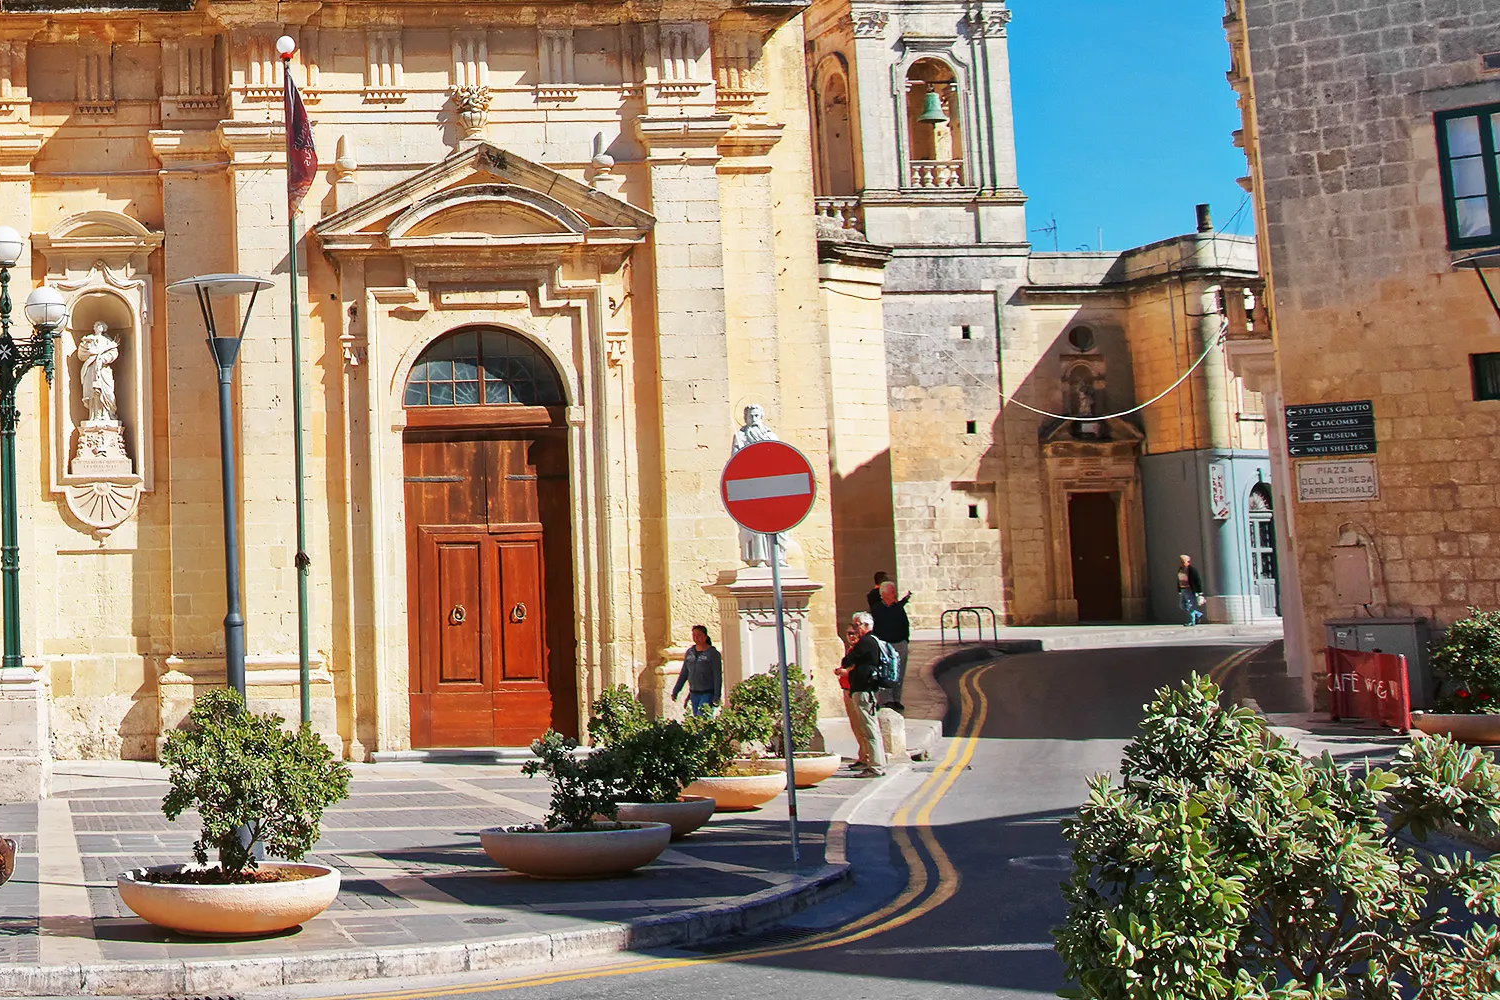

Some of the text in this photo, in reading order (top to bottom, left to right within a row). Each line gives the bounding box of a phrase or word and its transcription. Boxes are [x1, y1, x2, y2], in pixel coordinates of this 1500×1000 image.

[1335, 404, 1369, 412] GROTTO
[1310, 419, 1359, 427] CATACOMBS
[1306, 444, 1369, 453] WWII SHELTERS
[1317, 466, 1354, 474] PIAZZA
[1301, 475, 1373, 486] DELLA CHIESA
[1302, 485, 1374, 495] PARROCCHIALE
[1327, 670, 1360, 693] CAFÉ
